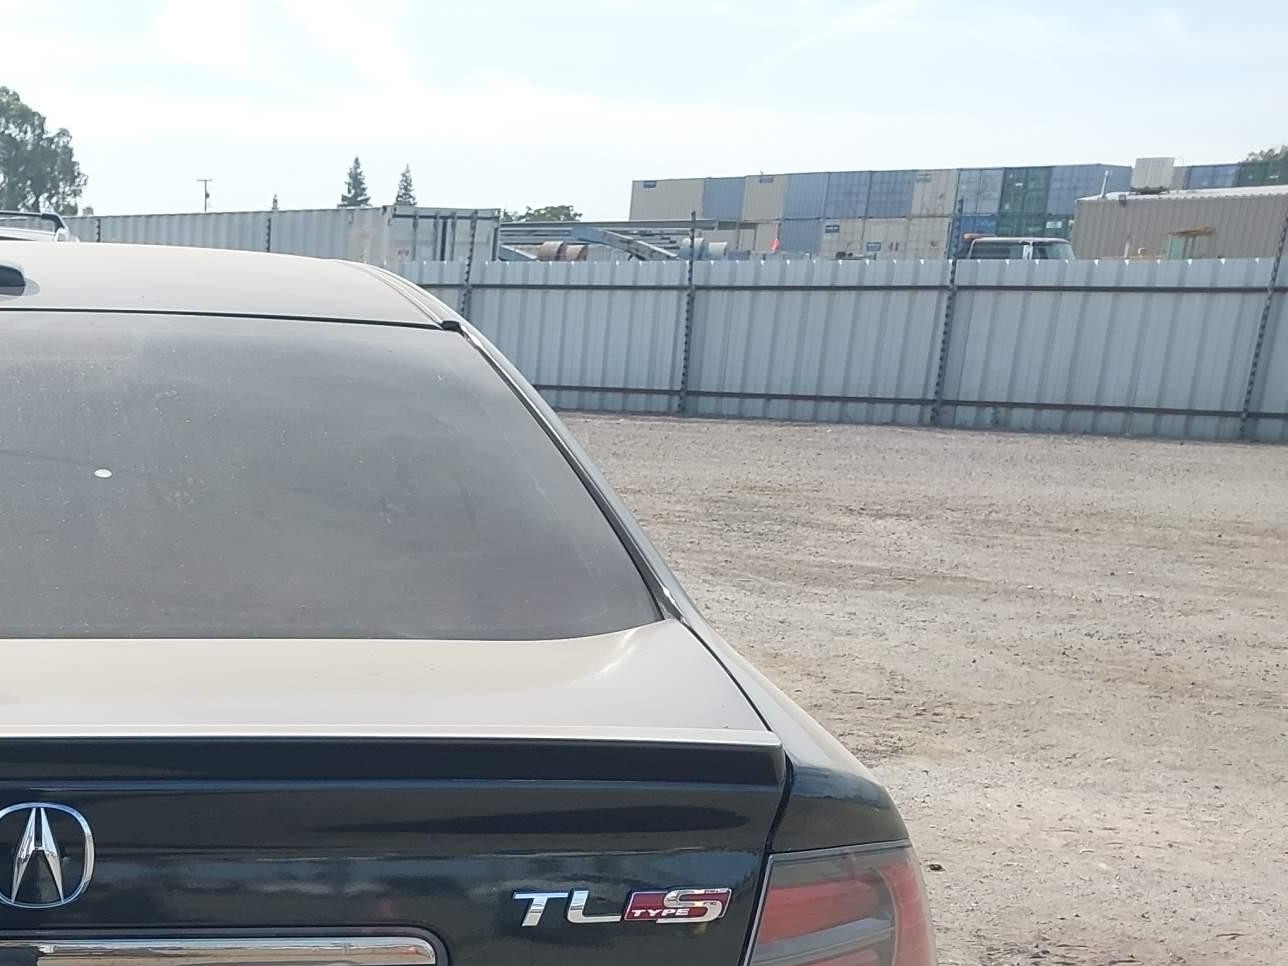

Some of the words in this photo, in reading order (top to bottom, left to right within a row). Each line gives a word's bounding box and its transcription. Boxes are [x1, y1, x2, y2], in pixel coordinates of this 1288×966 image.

[513, 890, 622, 927] TL
[631, 907, 690, 918] TYPE
[655, 887, 730, 924] S
